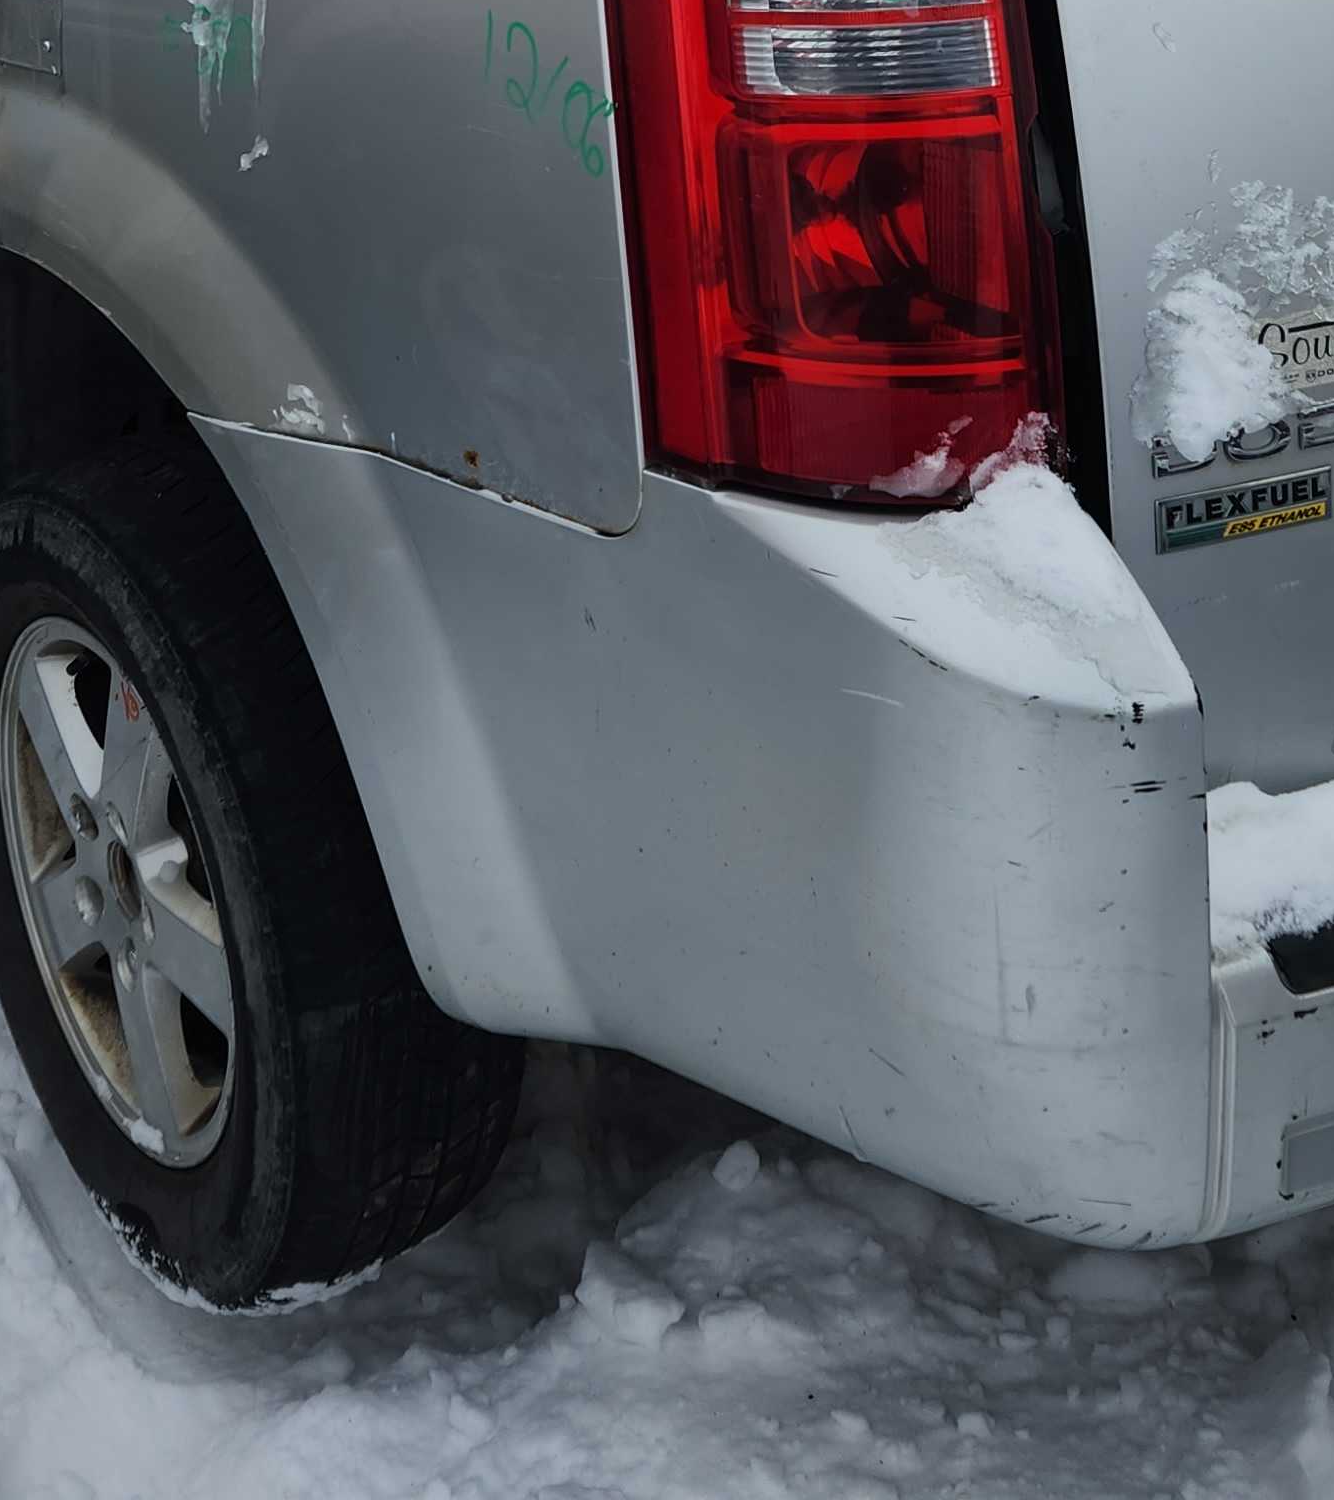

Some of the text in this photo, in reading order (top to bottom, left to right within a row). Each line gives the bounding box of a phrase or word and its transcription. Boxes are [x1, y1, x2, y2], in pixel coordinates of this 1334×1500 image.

[1165, 473, 1327, 529] FLEXFUEL
[1228, 504, 1323, 535] E85 ETHANOL
